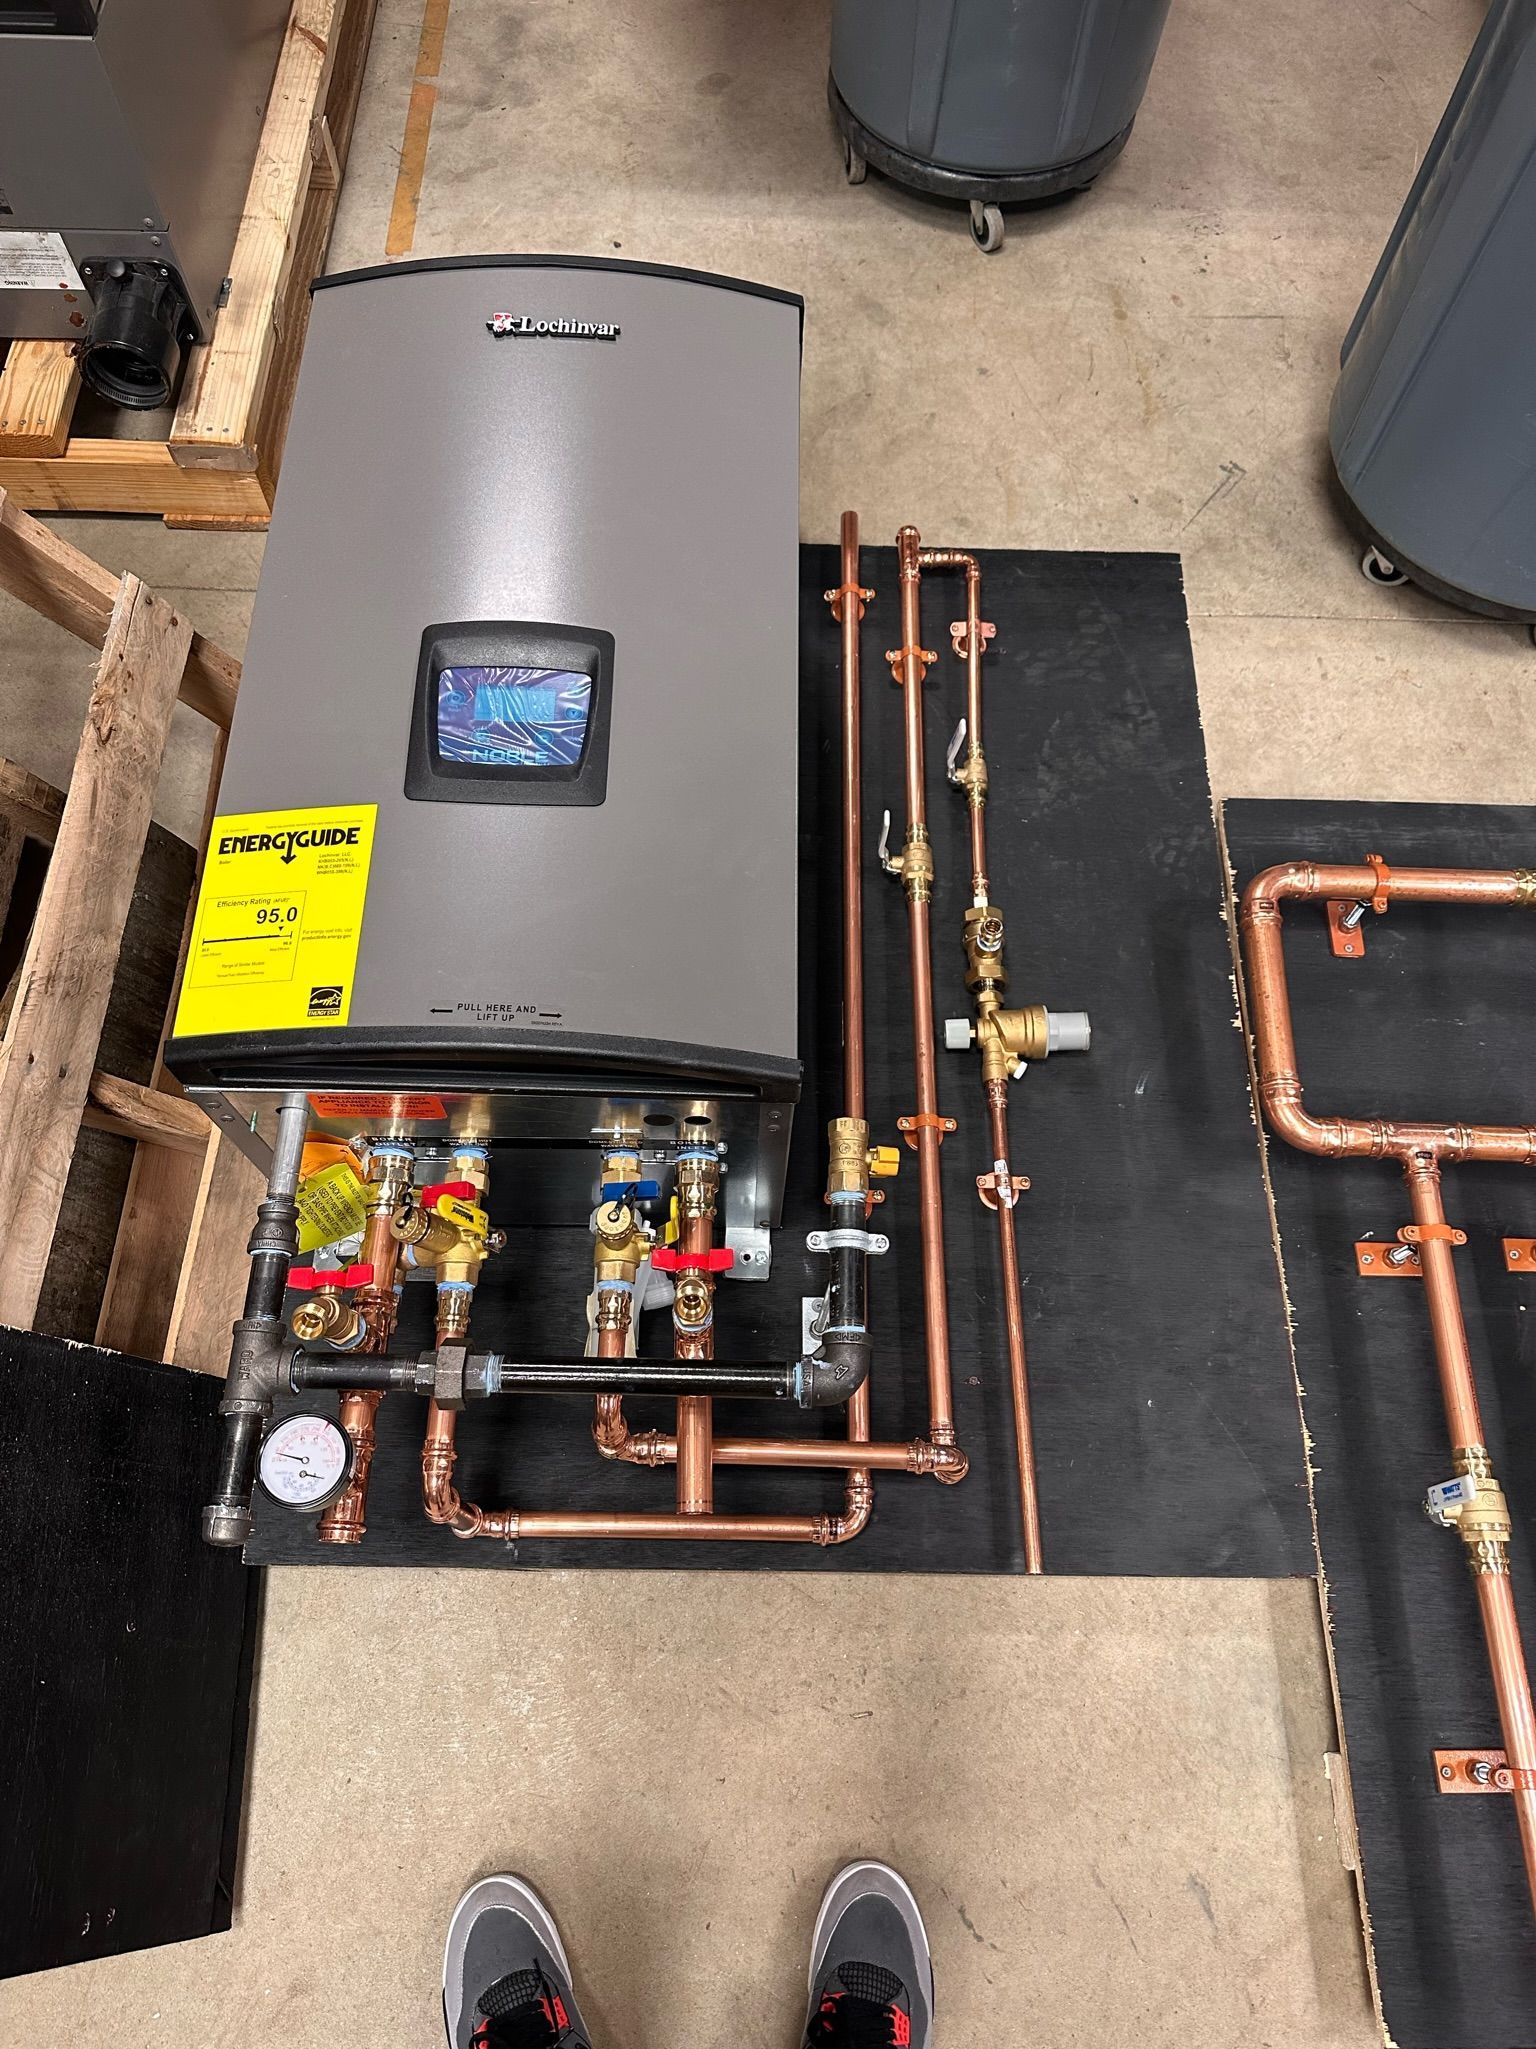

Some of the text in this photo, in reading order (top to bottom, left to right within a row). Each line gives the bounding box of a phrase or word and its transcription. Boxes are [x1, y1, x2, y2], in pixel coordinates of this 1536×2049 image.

[519, 316, 619, 335] Lochinvar
[472, 749, 549, 763] NOBLE
[218, 827, 361, 856] ENERGYGUIDE
[217, 900, 248, 908] Efficiency
[250, 897, 271, 905] Rating
[256, 906, 298, 924] 95.0
[457, 1003, 537, 1013] PULL HERE AND
[477, 1013, 515, 1022] LIFT UP
[315, 1185, 330, 1198] USED
[328, 1183, 342, 1196] BACK
[338, 1198, 355, 1214] WRENCH
[297, 1197, 309, 1208] AND
[311, 1197, 323, 1208] GAS
[317, 1205, 328, 1215] PIPE
[239, 1350, 254, 1381] WARD
